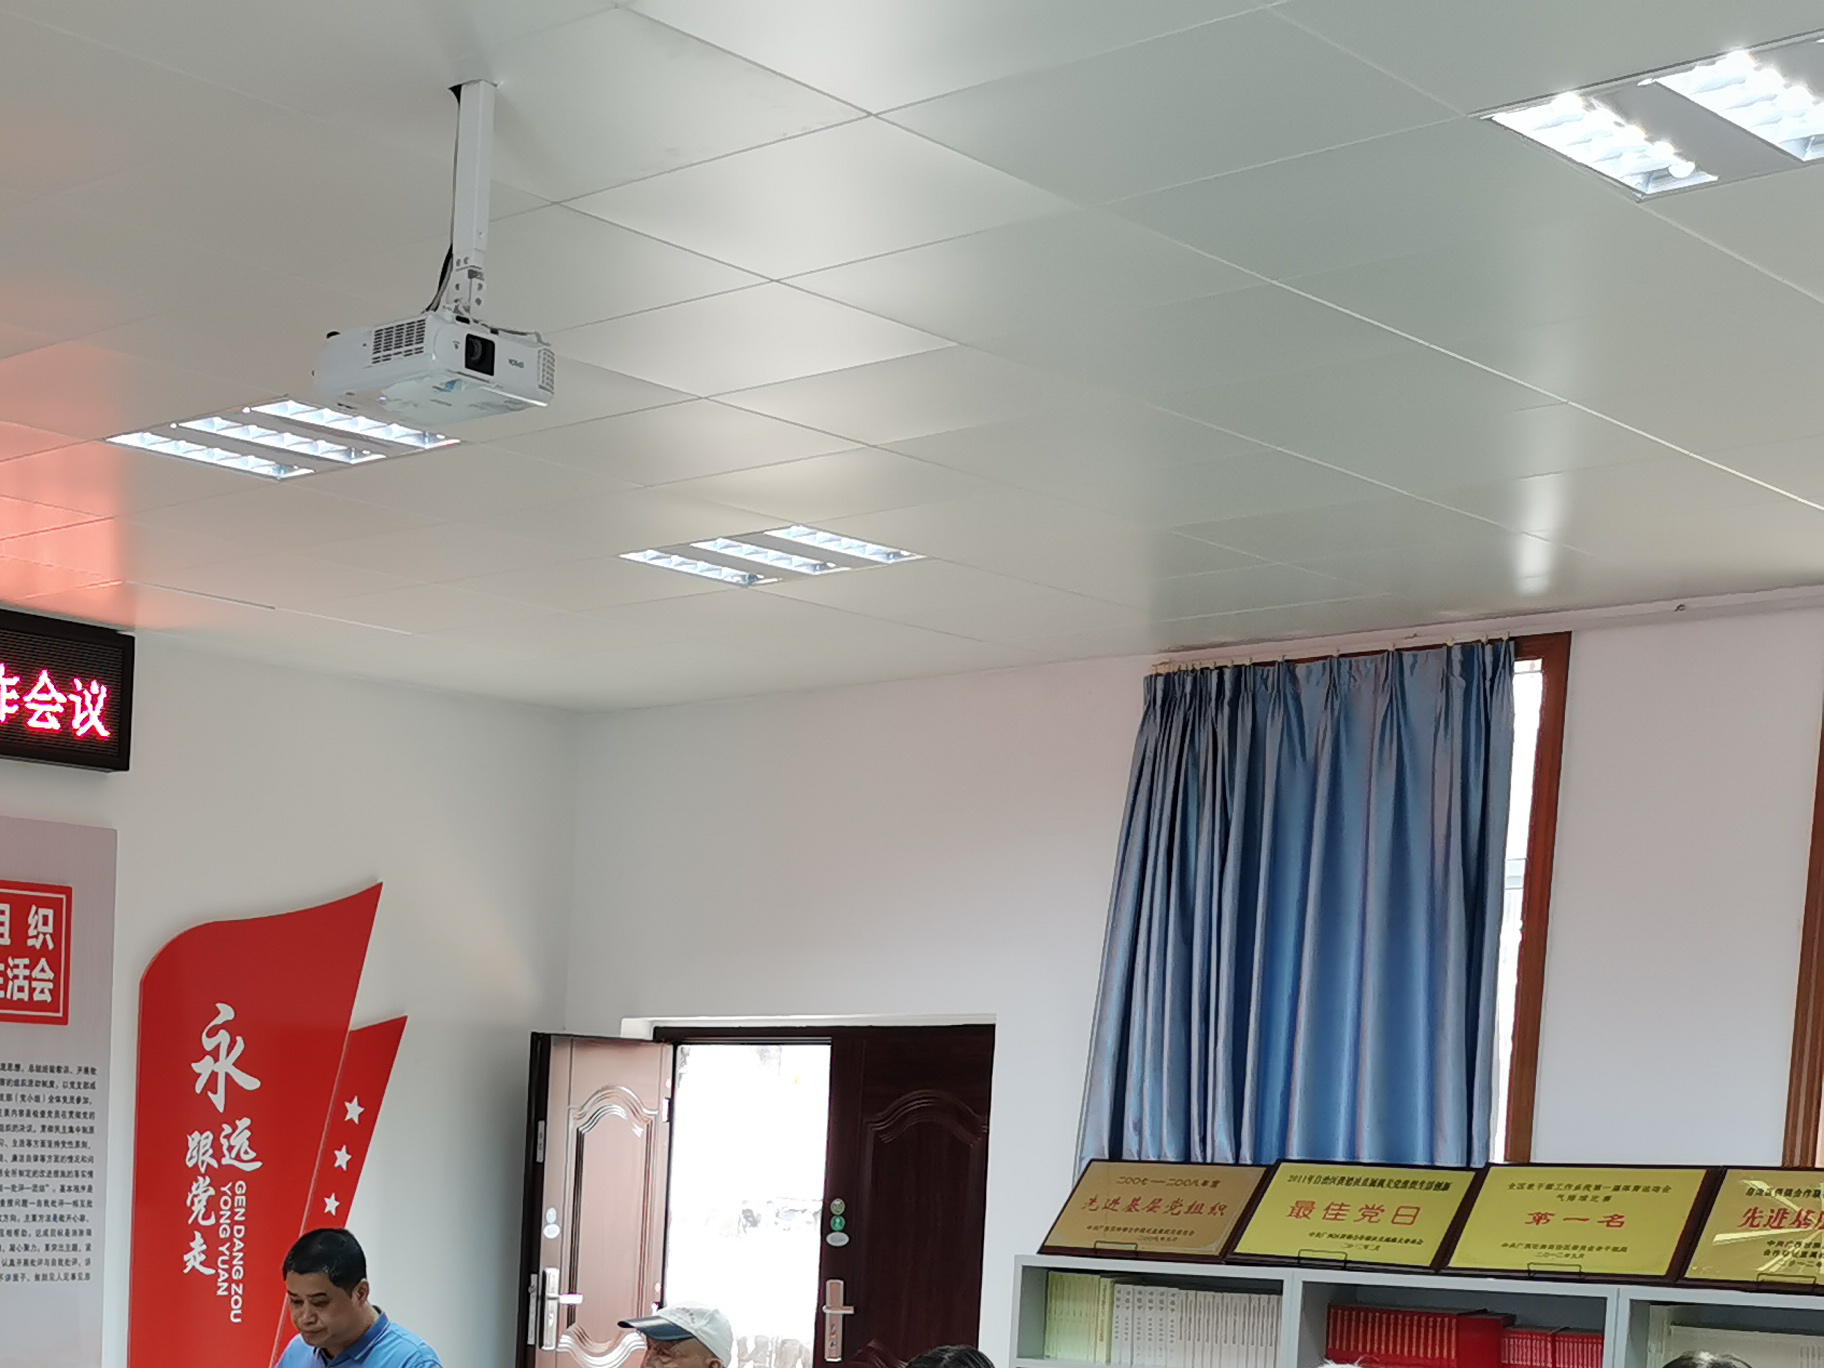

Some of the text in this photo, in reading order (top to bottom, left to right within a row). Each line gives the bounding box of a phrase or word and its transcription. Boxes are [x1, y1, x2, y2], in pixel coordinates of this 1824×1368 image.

[183, 1130, 219, 1275] 跟党走
[1081, 1195, 1228, 1217] 先进基层党组织
[1286, 1200, 1421, 1226] 最佳党日
[1525, 1211, 1626, 1229] 第一名
[216, 1182, 233, 1296] YONG YUAN
[230, 1180, 247, 1323] GEN DANG ZOU
